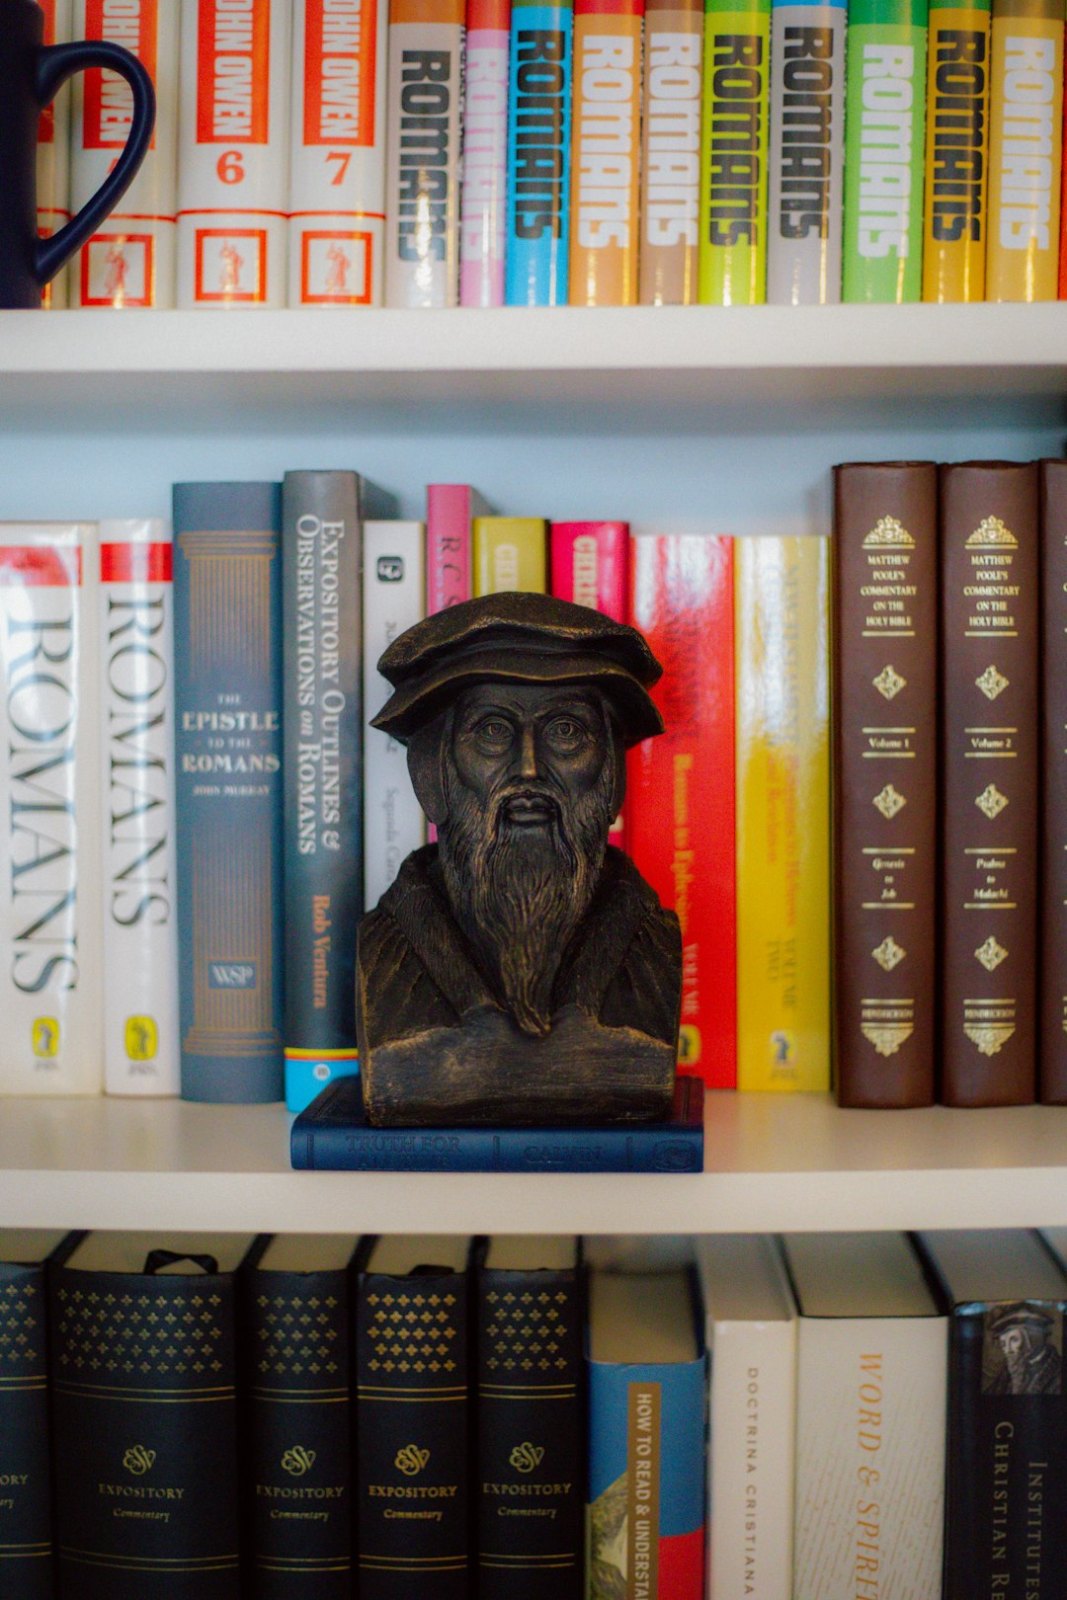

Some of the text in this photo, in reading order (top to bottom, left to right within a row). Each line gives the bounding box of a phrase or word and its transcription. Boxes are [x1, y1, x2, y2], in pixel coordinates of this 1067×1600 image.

[213, 56, 253, 137] OWEN
[320, 58, 360, 138] OWEN
[517, 29, 566, 240] ROMANS
[578, 34, 634, 248] ROMANS
[646, 32, 700, 248] ROMANS
[709, 34, 763, 248] ROMANS
[780, 26, 835, 240] ROMANS
[932, 29, 987, 242] ROMANS
[999, 35, 1055, 250] ROMANS
[857, 43, 914, 259] ROMANS
[215, 151, 245, 186] 6
[324, 152, 352, 187] 7
[867, 555, 910, 565] MATTHEW
[970, 555, 1013, 565] MATTHEW
[860, 586, 917, 596] COMMENTARY
[963, 586, 1020, 596] COMMENTARY
[873, 601, 904, 612] ON THE
[976, 601, 1007, 612] ON THE
[866, 616, 912, 627] HOLY BIBLE
[969, 616, 1014, 627] HOLY BIBLE
[296, 513, 323, 856] OBSERVATIONS on ROMANS
[320, 520, 346, 851] EXPOSITORY OUTLINES &
[216, 692, 242, 704] THE
[181, 711, 280, 732] EPISTLE
[207, 738, 251, 750] TO THE
[869, 738, 902, 749] Volume
[971, 738, 1004, 749] Volume
[107, 593, 170, 927] ROMANS
[181, 753, 281, 774] ROMANS
[8, 613, 80, 994] ROMANS
[311, 894, 332, 1009] Rob Ventura
[636, 1392, 653, 1432] HOW
[857, 1352, 884, 1453] WORD
[636, 1435, 652, 1456] TO
[635, 1458, 652, 1498] READ
[743, 1367, 759, 1596] DOCTRINA CRISTIANA
[856, 1464, 881, 1488] &
[98, 1482, 185, 1500] EXPOSITORY
[256, 1483, 345, 1499] EXPOSITORY
[368, 1485, 458, 1499] EXPOSITORY
[483, 1482, 572, 1496] EXPOSITORY
[992, 1421, 1015, 1560] CHRISTIAN
[112, 1506, 171, 1523] Commentary
[269, 1508, 330, 1522] Commentary
[383, 1507, 444, 1521] Commentary
[496, 1505, 557, 1519] Commentary
[635, 1504, 651, 1516] &
[1025, 1461, 1049, 1600] INSTITUTES
